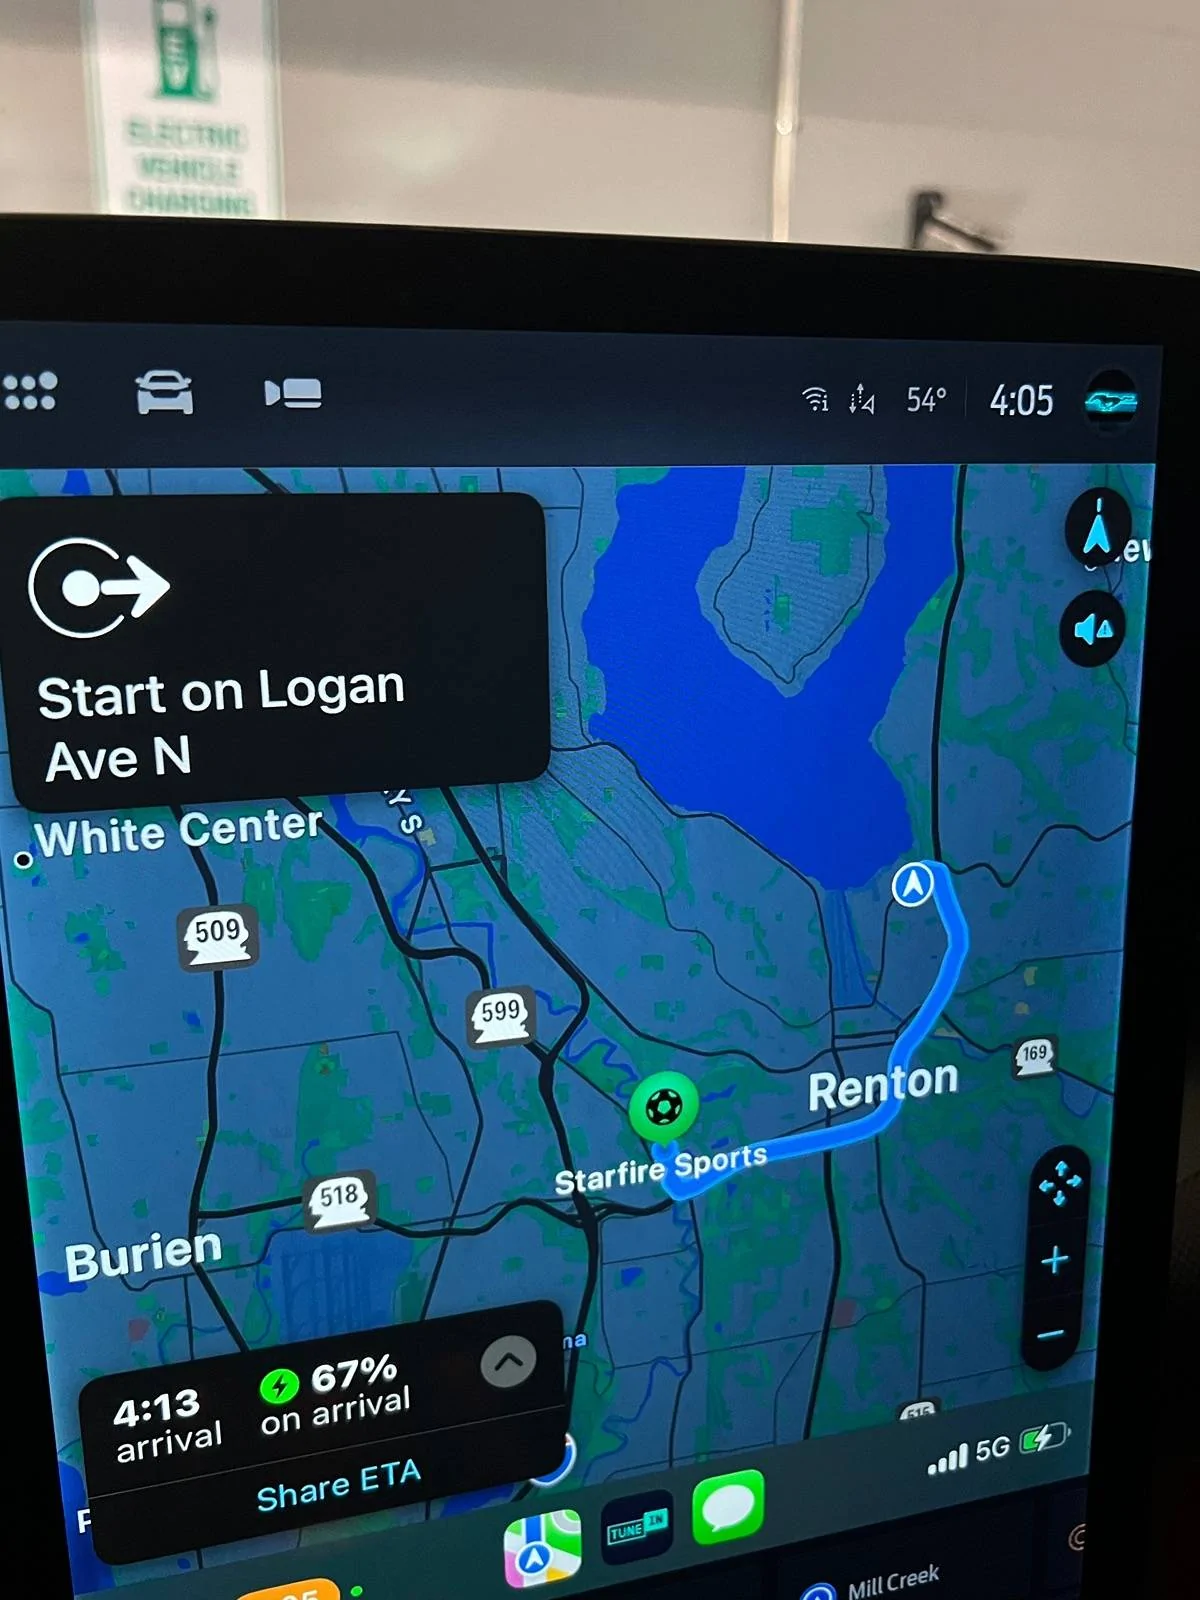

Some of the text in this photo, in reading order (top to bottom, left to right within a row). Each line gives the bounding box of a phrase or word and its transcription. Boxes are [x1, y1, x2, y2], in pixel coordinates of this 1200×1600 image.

[906, 384, 1054, 417] 54° 4:05
[38, 668, 405, 720] Start on Logan
[45, 734, 192, 782] Ave N
[34, 808, 324, 858] White Center
[194, 918, 241, 944] 509
[481, 999, 521, 1023] 599
[1023, 1044, 1048, 1063] 169
[808, 1064, 959, 1112] Renton
[554, 1145, 769, 1196] Starfire Sports
[320, 1183, 359, 1208] 518
[65, 1230, 223, 1283] Burien
[311, 1353, 398, 1394] 67%
[112, 1388, 201, 1428] 4:13
[261, 1385, 411, 1436] on arrival
[116, 1420, 222, 1464] arrival
[975, 1435, 1011, 1462] 5G
[257, 1457, 422, 1513] Share ETA
[610, 1523, 643, 1540] TUNE
[648, 1513, 664, 1526] IN
[848, 1563, 940, 1600] Mill Creek
